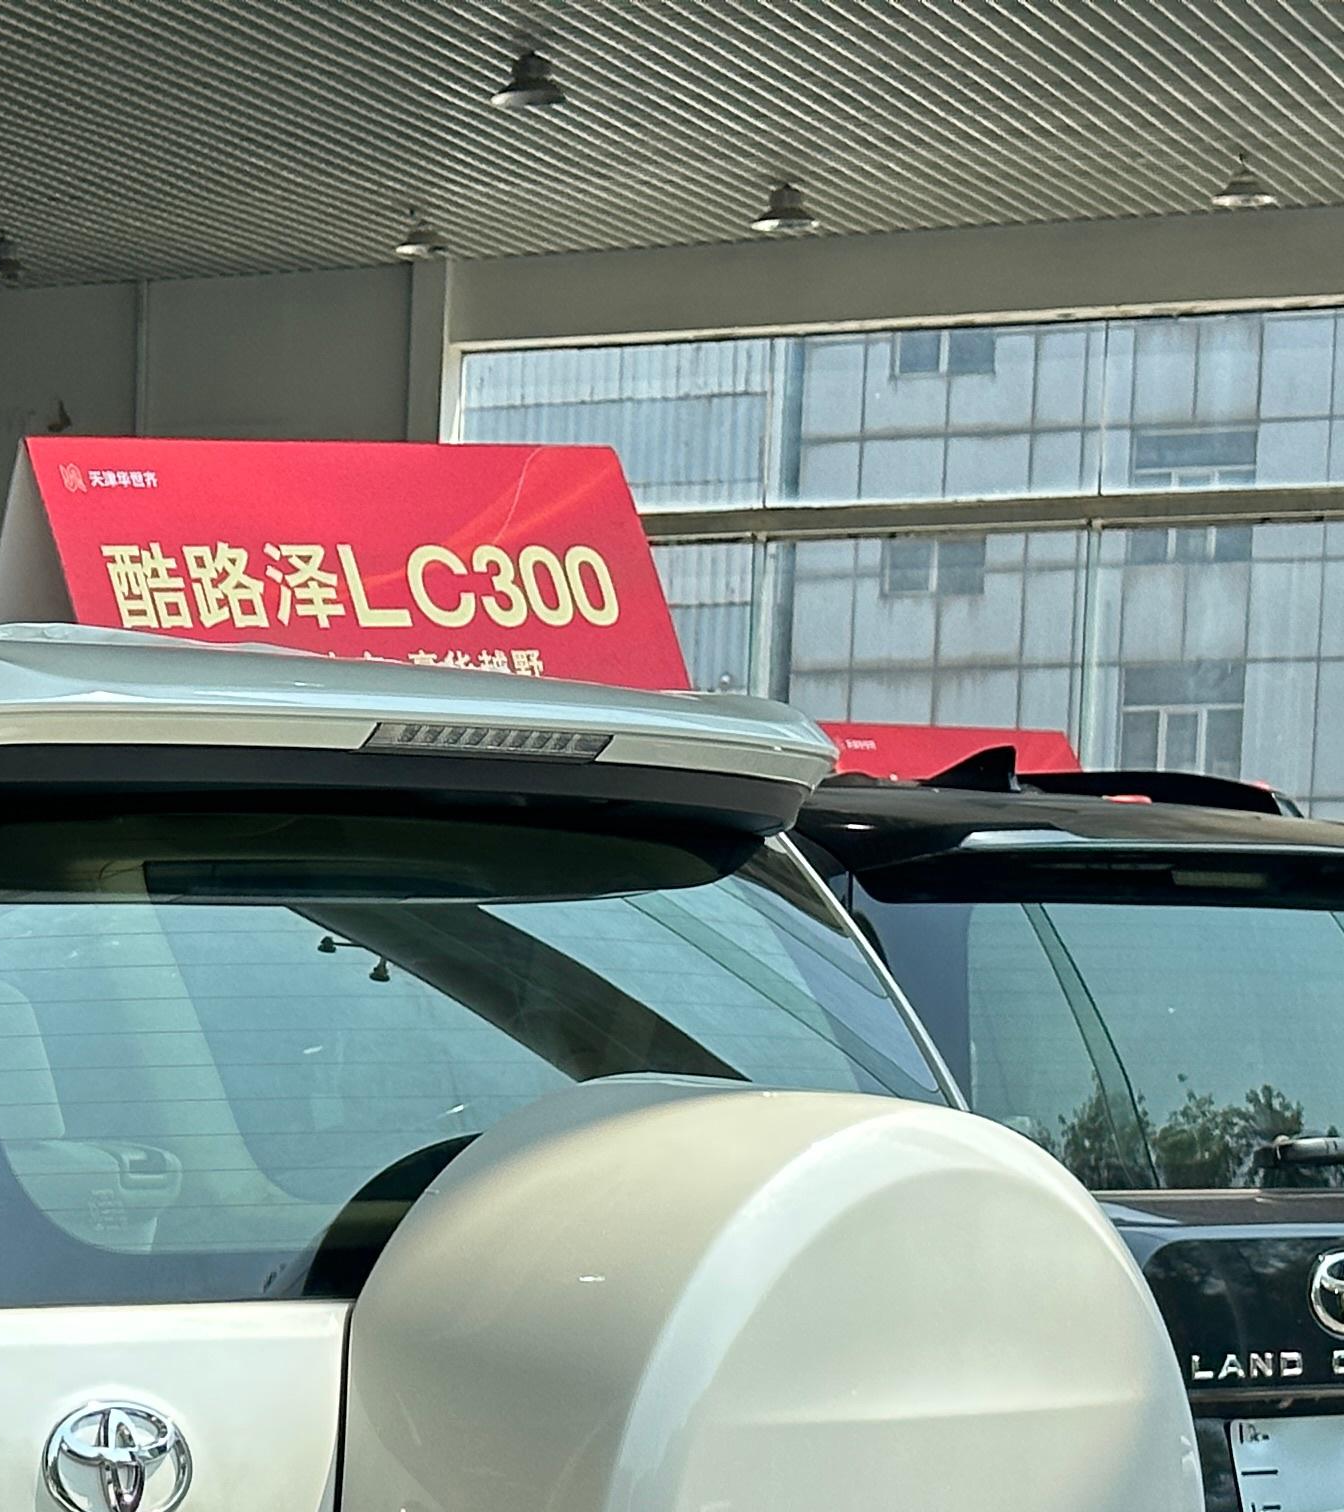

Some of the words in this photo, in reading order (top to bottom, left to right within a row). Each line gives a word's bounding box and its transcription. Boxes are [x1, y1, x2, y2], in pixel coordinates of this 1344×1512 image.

[100, 540, 621, 630] 酷路泽LC300
[1191, 1351, 1304, 1380] LAND
